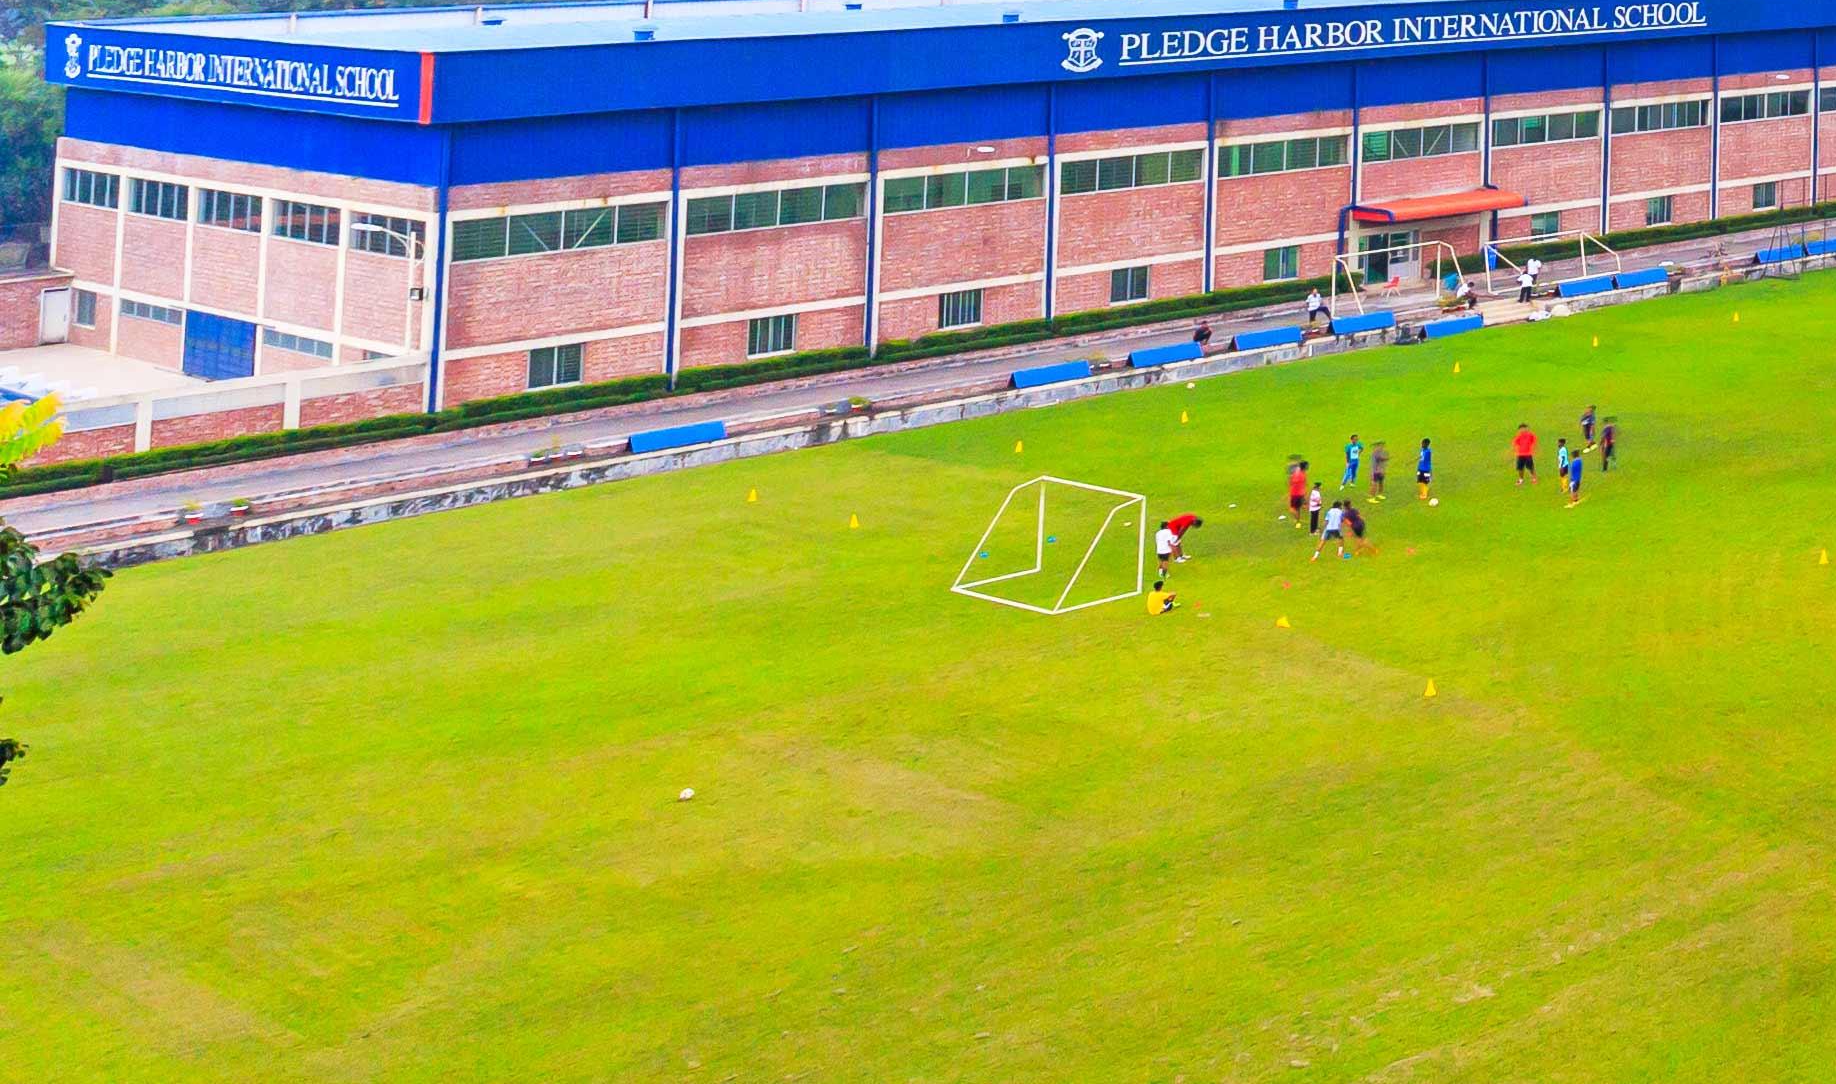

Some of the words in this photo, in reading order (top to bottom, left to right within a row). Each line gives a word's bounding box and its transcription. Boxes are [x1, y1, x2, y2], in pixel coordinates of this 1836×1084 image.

[1120, 27, 1249, 60] PLEDGE
[1257, 19, 1384, 51] HARBOR
[1393, 7, 1608, 42] INTERNATIONAL
[1613, 2, 1706, 29] SCHOOL
[88, 45, 142, 75] PLEDGE
[144, 49, 206, 82] HARBOR
[208, 54, 332, 95] INTERNATIONAL
[335, 66, 399, 101] SCHOOL
